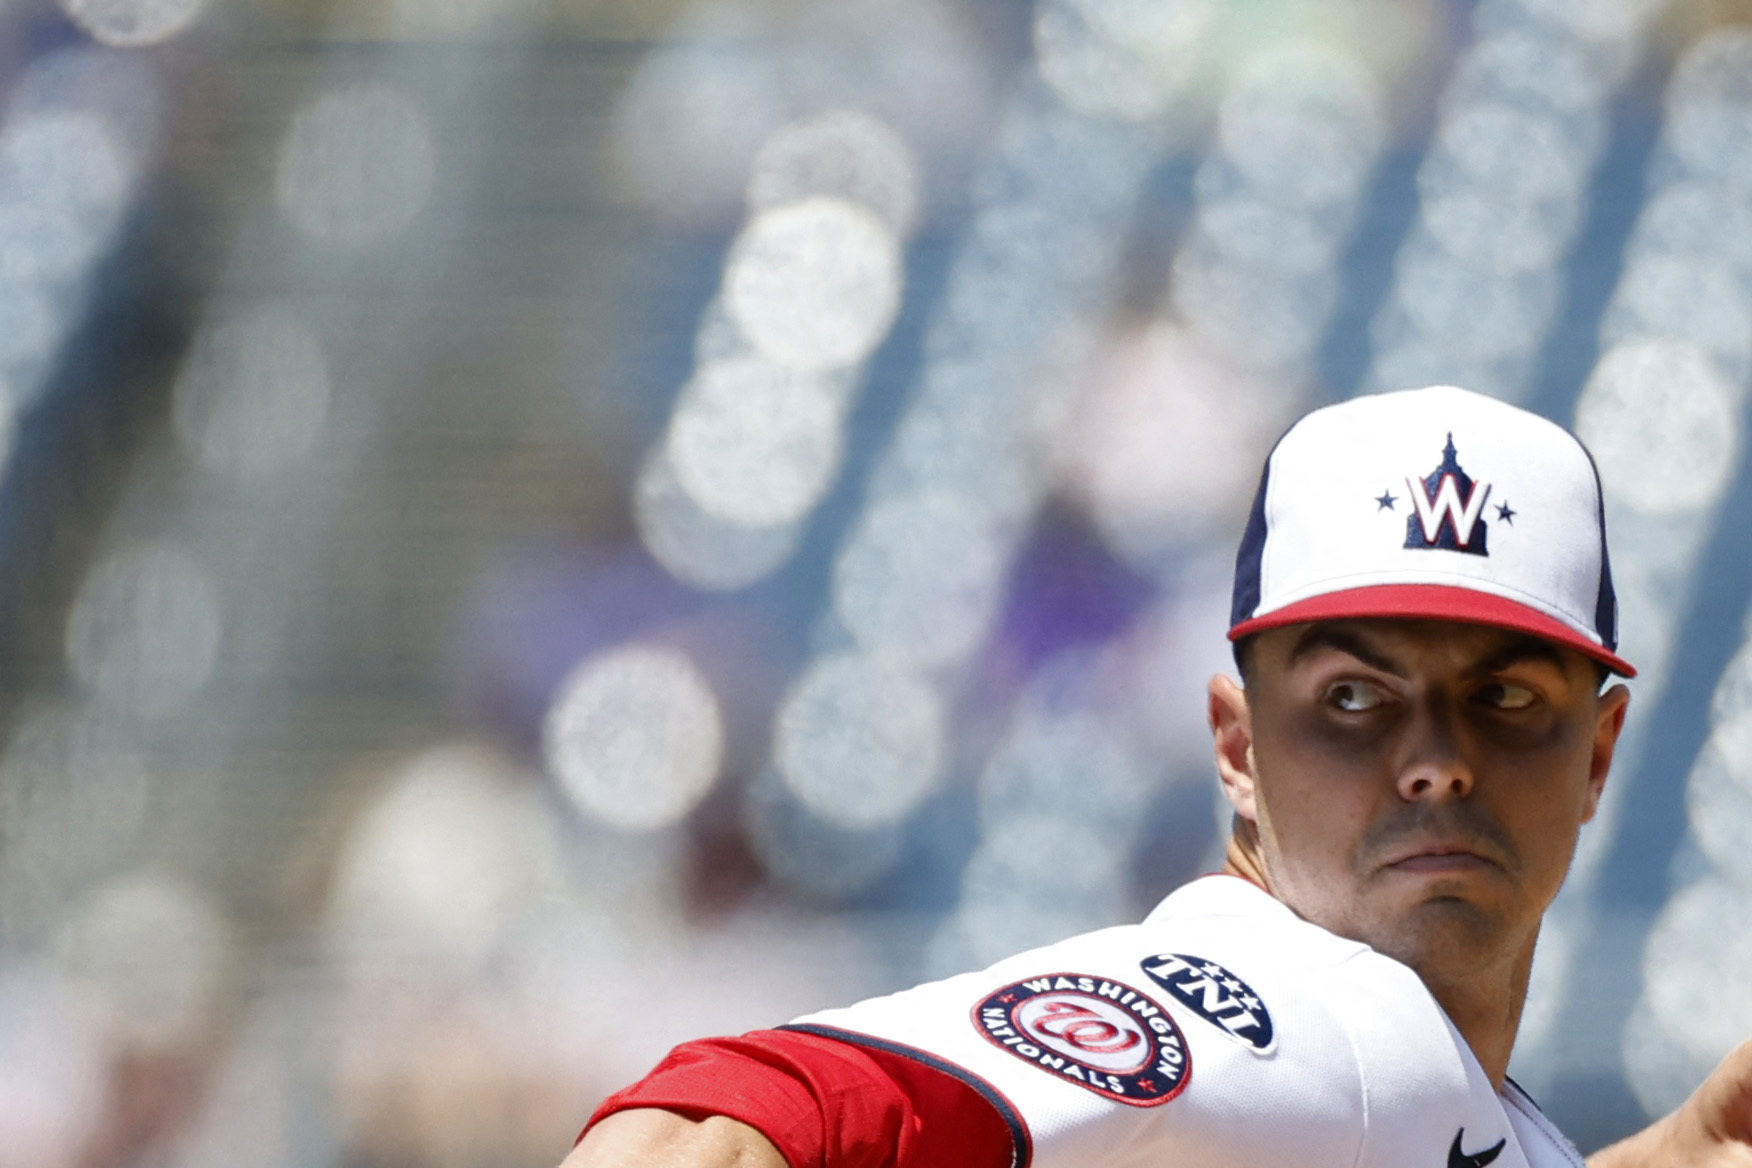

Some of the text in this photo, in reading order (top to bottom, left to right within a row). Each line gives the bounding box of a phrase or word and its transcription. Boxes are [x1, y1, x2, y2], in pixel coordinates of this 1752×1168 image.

[1405, 471, 1491, 549] W
[982, 1007, 1126, 1094] NATIONALS
[1022, 976, 1184, 1081] WASHINGTON
